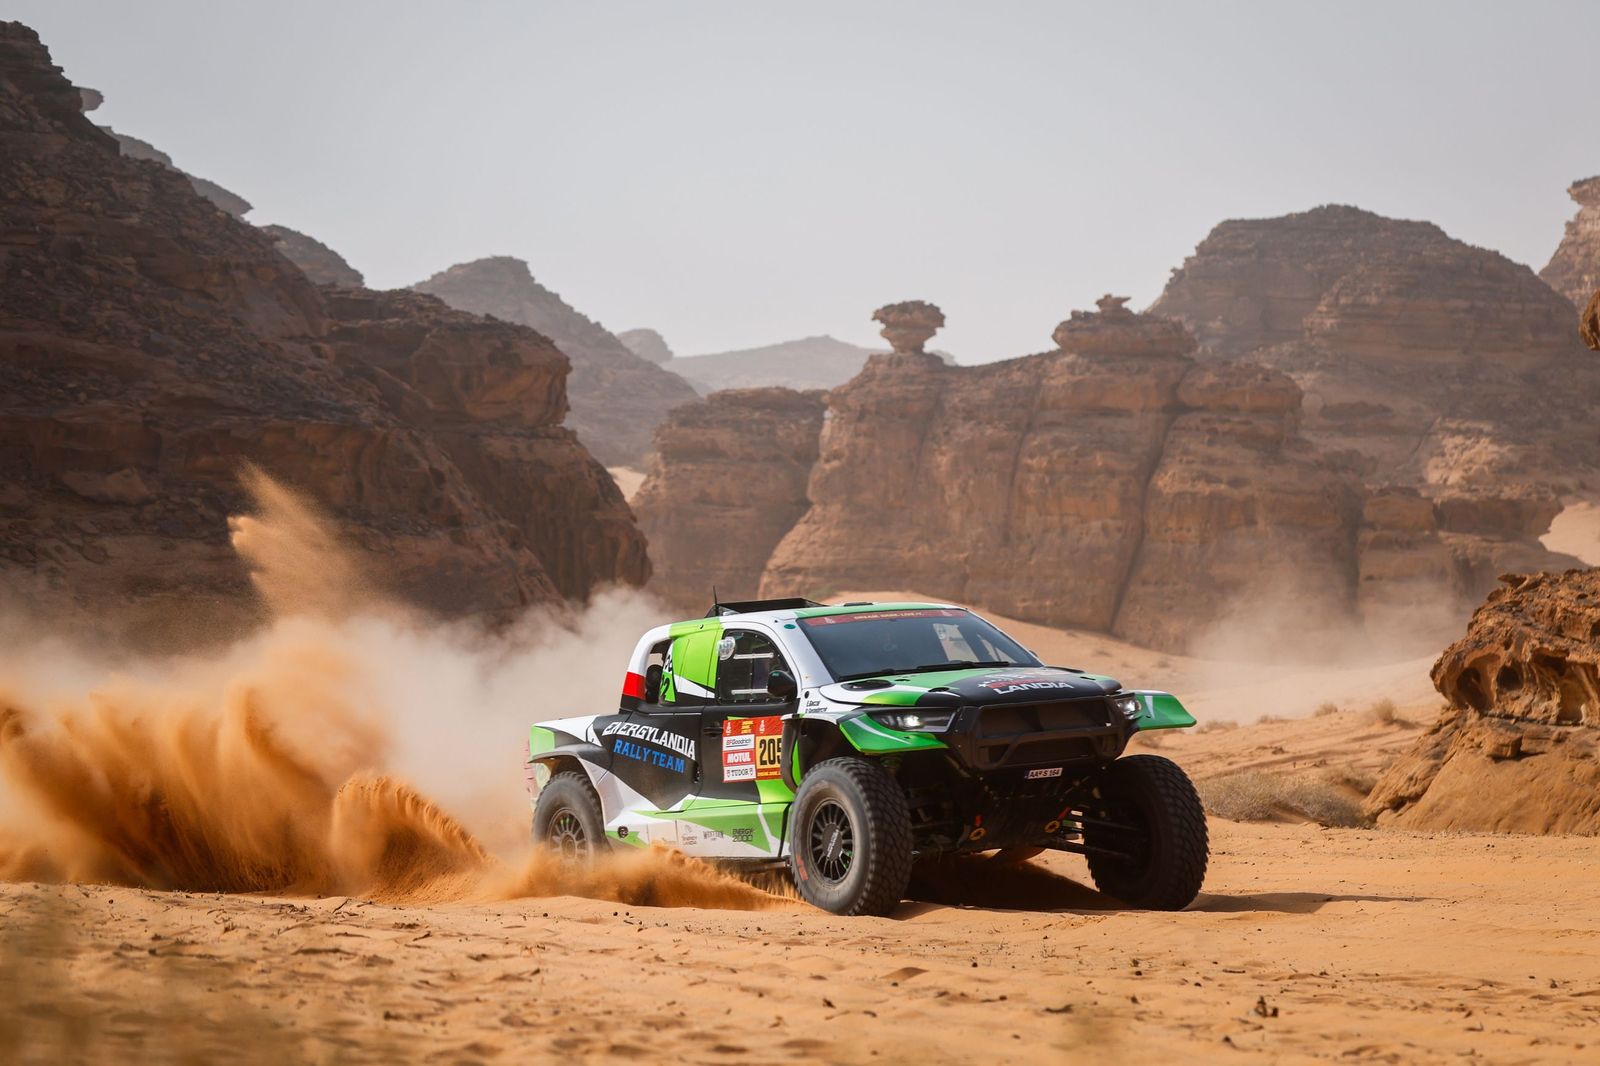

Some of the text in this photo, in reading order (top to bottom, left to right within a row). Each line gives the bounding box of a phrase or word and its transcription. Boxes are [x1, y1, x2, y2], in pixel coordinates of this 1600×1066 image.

[993, 681, 1074, 695] LANDIA
[602, 722, 696, 761] ENERGYLANDIA
[759, 738, 782, 766] 205
[613, 739, 685, 773] RALLY TEAM
[727, 752, 751, 764] MOTUL
[731, 768, 749, 777] TUDOR
